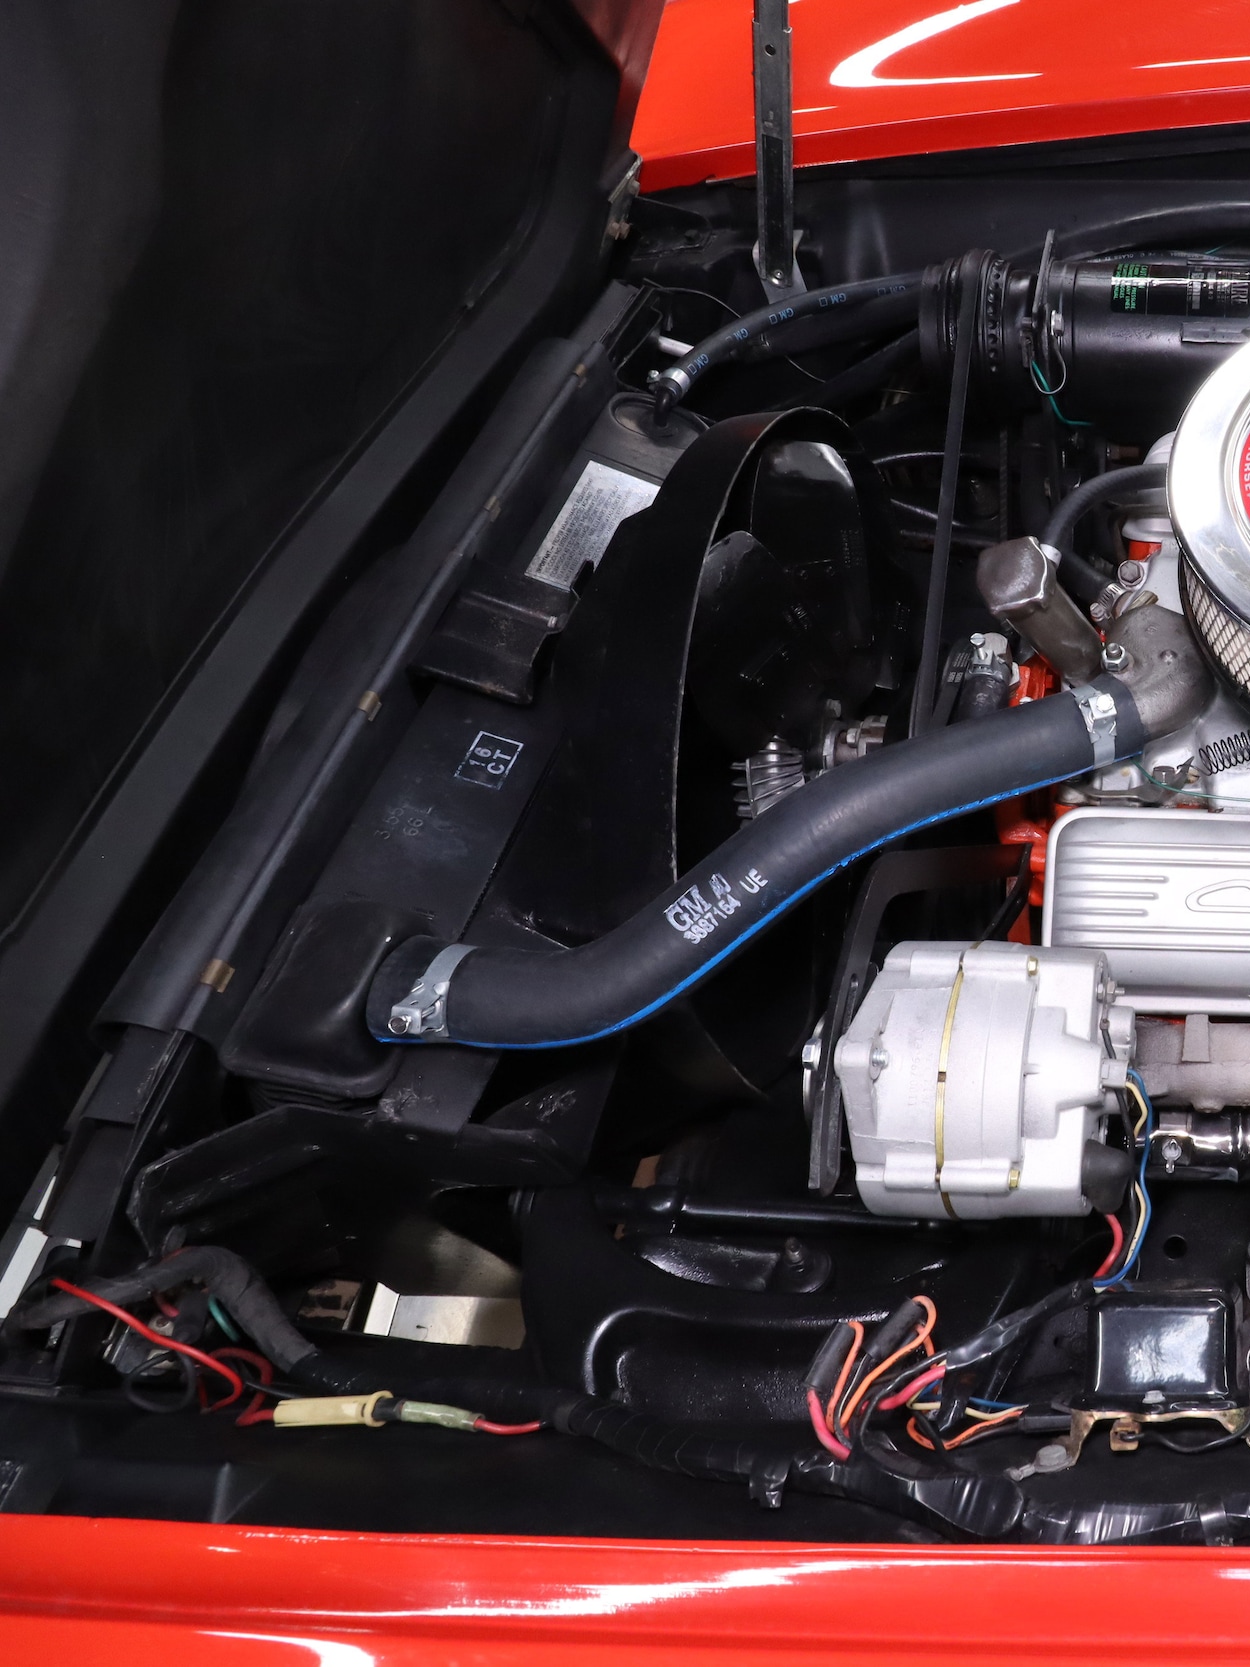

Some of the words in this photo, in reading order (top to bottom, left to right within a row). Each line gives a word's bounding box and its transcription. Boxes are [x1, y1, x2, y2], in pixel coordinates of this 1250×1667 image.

[830, 292, 847, 304] GM
[780, 307, 794, 321] GM
[734, 328, 748, 341] GM
[696, 353, 709, 369] GM
[486, 749, 512, 775] CT
[738, 868, 768, 894] UE
[665, 884, 712, 932] GM
